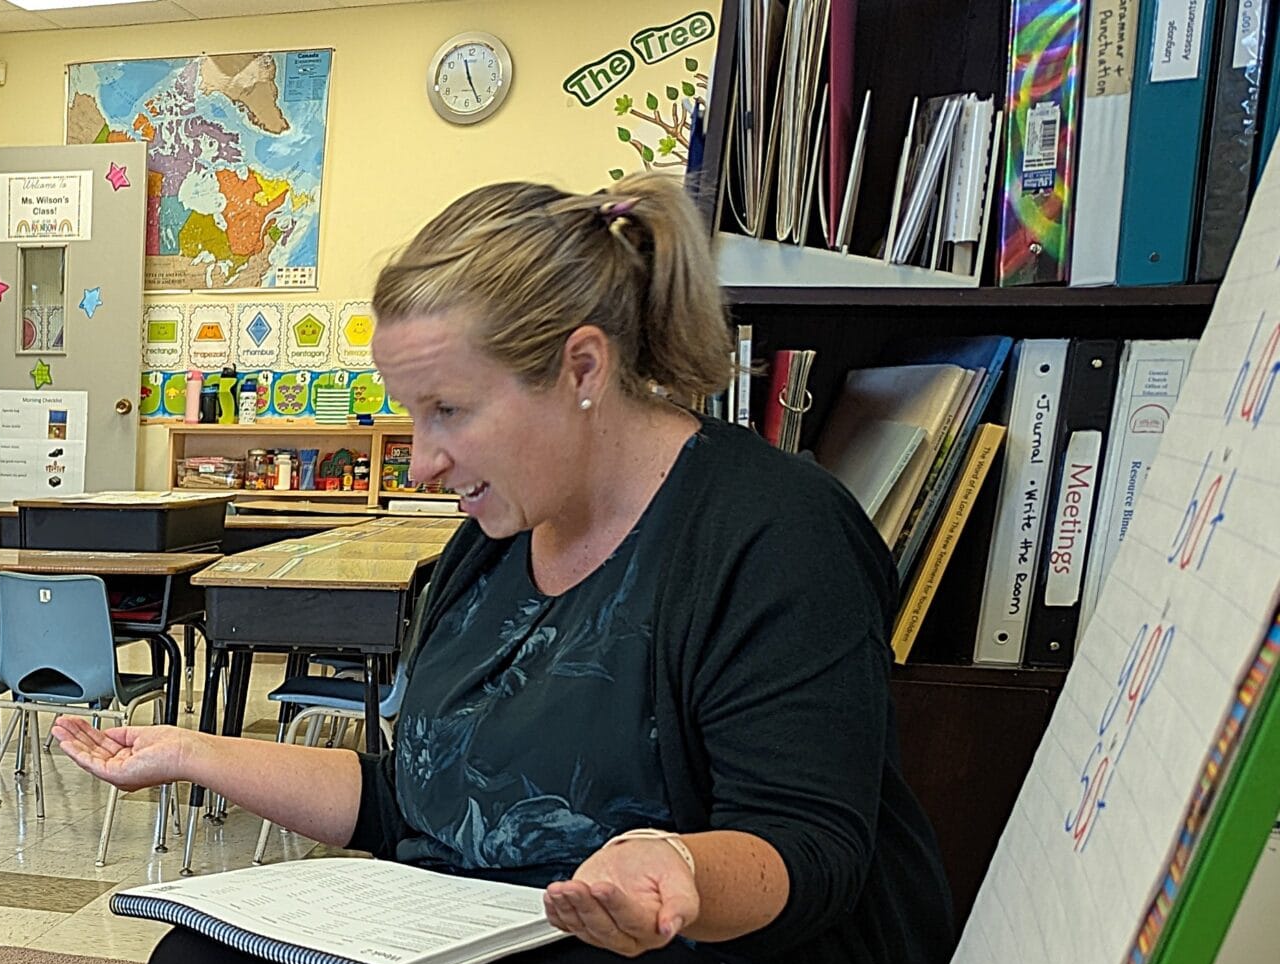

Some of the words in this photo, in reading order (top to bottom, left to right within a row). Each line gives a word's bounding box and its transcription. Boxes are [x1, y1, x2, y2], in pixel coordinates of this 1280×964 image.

[1182, 0, 1198, 60] Assessments
[1161, 20, 1177, 64] Language
[457, 53, 463, 61] 11
[469, 47, 476, 57] 12
[482, 52, 486, 60] 1
[1096, 10, 1113, 96] Punctuation
[570, 56, 628, 101] The
[635, 16, 708, 60] Tree
[448, 62, 455, 70] 10
[488, 60, 493, 68] 2
[442, 74, 448, 83] 9
[491, 73, 496, 82] 3
[445, 88, 450, 96] 8
[486, 86, 491, 94] 4
[453, 96, 458, 104] 7
[464, 99, 470, 108] 6
[36, 196, 69, 204] Wilson's
[33, 207, 56, 215] Class!
[291, 350, 325, 358] pentagon
[262, 372, 269, 382] 4
[300, 374, 306, 382] 5
[338, 373, 344, 382] 6
[1030, 399, 1051, 464] Journal
[981, 447, 991, 459] The
[974, 461, 987, 480] Word
[1125, 461, 1142, 510] Resource
[959, 499, 969, 518] Lord
[1021, 487, 1038, 531] Write
[1049, 463, 1093, 575] Meetings
[1018, 538, 1033, 565] the
[931, 549, 949, 583] Testament
[1008, 573, 1028, 615] Room
[902, 612, 919, 643] Children
